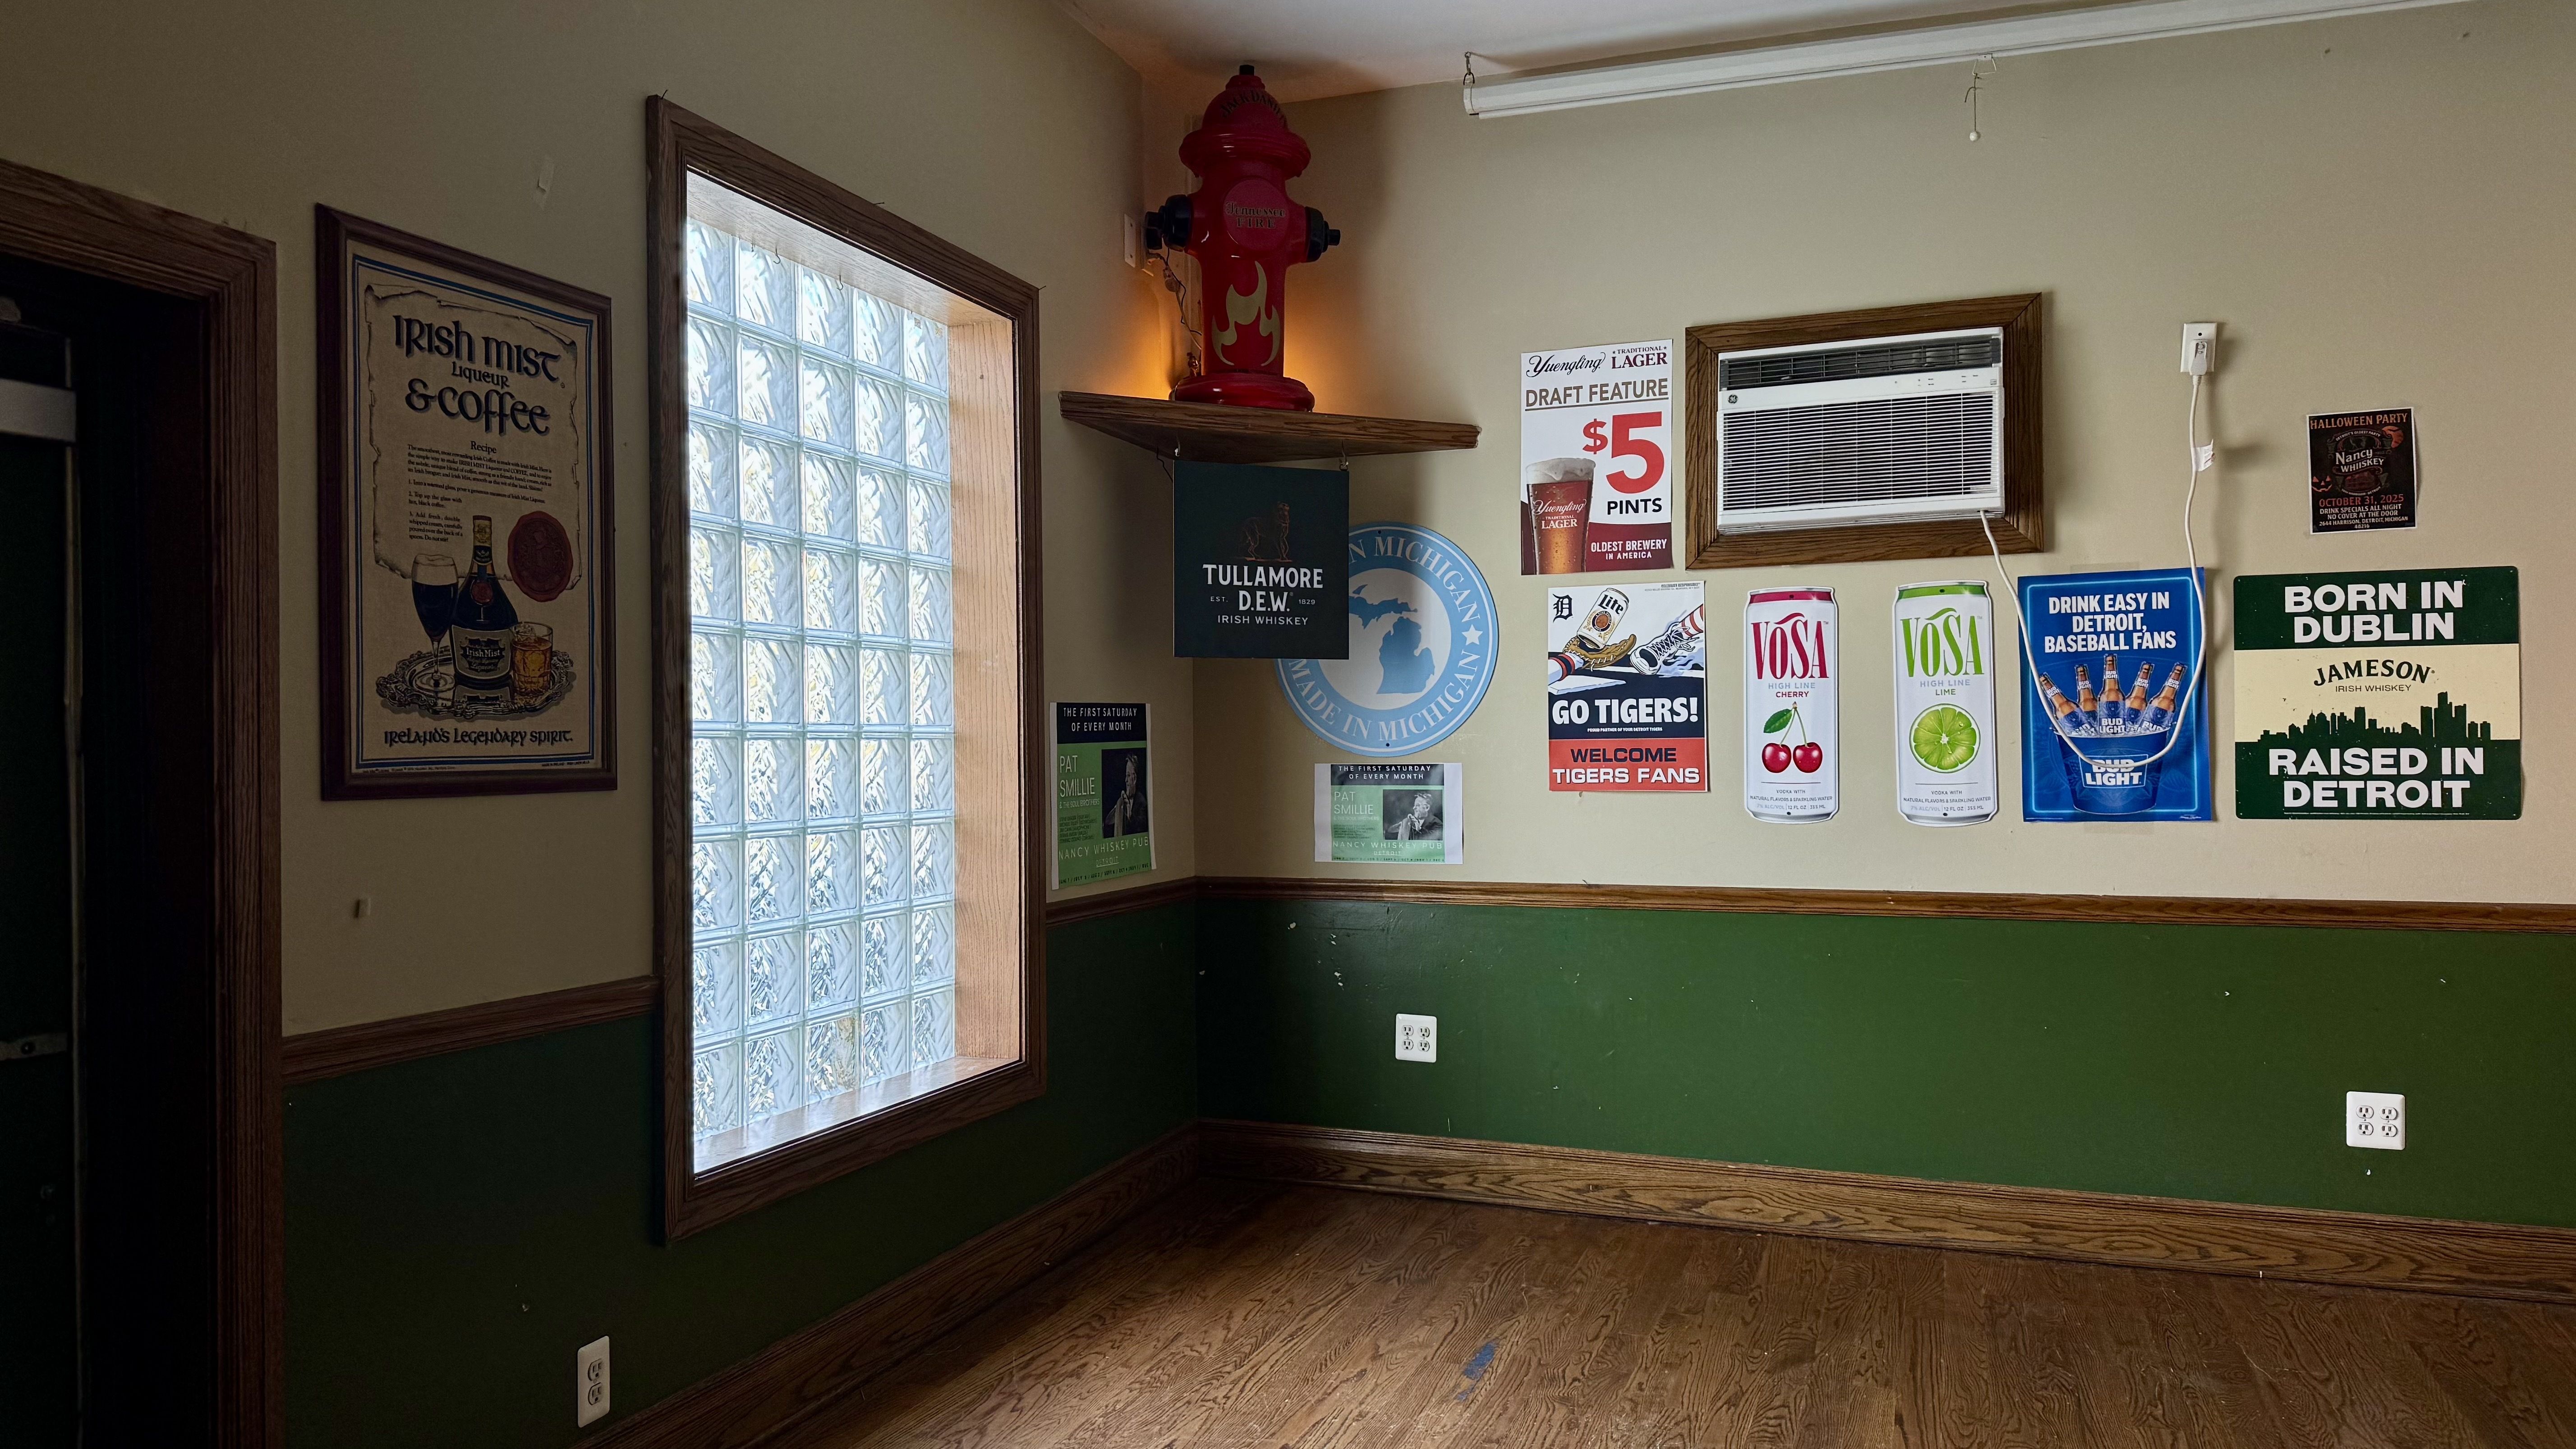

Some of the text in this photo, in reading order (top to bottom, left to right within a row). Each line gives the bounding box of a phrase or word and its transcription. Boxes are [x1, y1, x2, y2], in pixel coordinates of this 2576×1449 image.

[1226, 201, 1284, 217] Tennessee
[1237, 217, 1276, 229] FIRE
[1617, 346, 1663, 354] TRADITIONAL
[1526, 352, 1606, 378] Yuengling
[1611, 352, 1668, 369] LAGER
[1526, 378, 1668, 407] DRAFT FEATURE
[2310, 413, 2409, 429] HALLOWEEN PARTY
[471, 441, 497, 454] Recipe
[2335, 449, 2373, 465] Nancy
[1533, 499, 1587, 515] Yuengling
[1607, 498, 1662, 515] PINTS
[2319, 494, 2405, 507] OCTOBER 31, 2025
[1541, 519, 1578, 529] LAGER
[1591, 538, 1667, 552] OLDEST BREWERY
[1617, 551, 1652, 560] AMERICA
[1202, 564, 1324, 589] TULLAMORE
[1348, 536, 1481, 623] N MICHIGAN
[1239, 590, 1290, 612] D.E.W.
[1598, 594, 1624, 614] Lite
[2049, 591, 2170, 614] DRINK EASY IN
[2285, 580, 2464, 613] BORN IN
[1218, 615, 1308, 626] IRISH WHISKEY
[2072, 612, 2147, 633] DETROIT,
[2294, 612, 2455, 644] DUBLIN
[2044, 630, 2176, 653] BASEBALL FANS
[466, 647, 484, 658] Irish
[2314, 659, 2431, 686] JAMESON
[1288, 649, 1481, 741] MADE IN MICHIGAN
[2365, 684, 2412, 692] WHISKEY
[1063, 707, 1137, 717] THE FIRST SATURDAY
[1552, 697, 1698, 725] GO TIGERS!
[1071, 722, 1132, 732] OF EVERY MONTH
[2100, 725, 2125, 733] LIGHT
[1570, 747, 1677, 763] WELCOME
[2269, 747, 2484, 776] RAISED IN
[1060, 755, 1078, 773] PAT
[2092, 759, 2135, 773] BUD
[1552, 768, 1700, 784] TIGERS FANS
[2085, 772, 2143, 786] LIGHT
[1060, 777, 1095, 798] SMILLIE
[2284, 779, 2470, 808] DETROIT
[1334, 791, 1356, 802] PAT
[1334, 804, 1374, 815] SMILLIE
[1058, 837, 1149, 860] NANCY WHISKEY PUB
